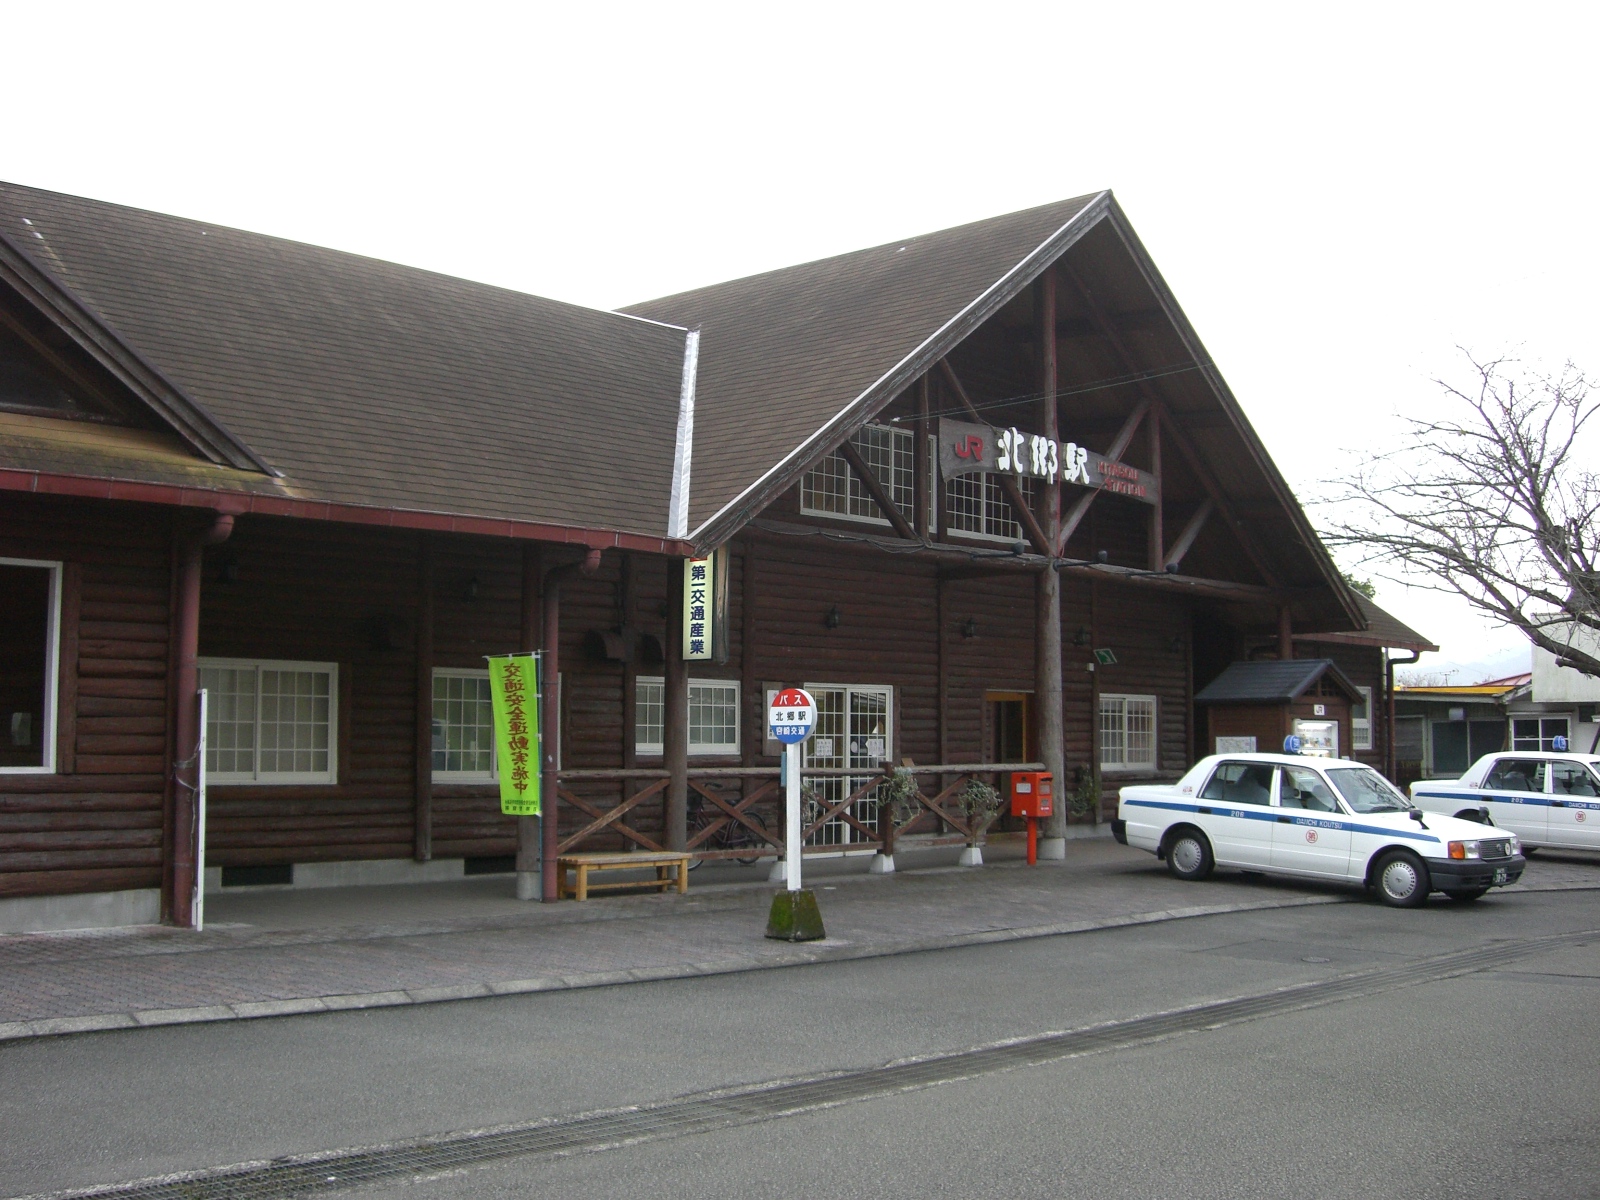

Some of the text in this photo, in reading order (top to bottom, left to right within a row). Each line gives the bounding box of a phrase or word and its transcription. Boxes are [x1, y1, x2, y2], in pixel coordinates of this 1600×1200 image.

[955, 434, 984, 461] JR
[996, 426, 1090, 484] 北郷駅
[1104, 477, 1147, 497] STATION
[689, 565, 706, 655] 第一交通産業
[779, 694, 802, 705] バス
[775, 710, 807, 722] 北郷駅
[775, 726, 806, 736] 宮崎交通
[1230, 810, 1245, 818] 206
[1319, 820, 1343, 830] KOUTSU
